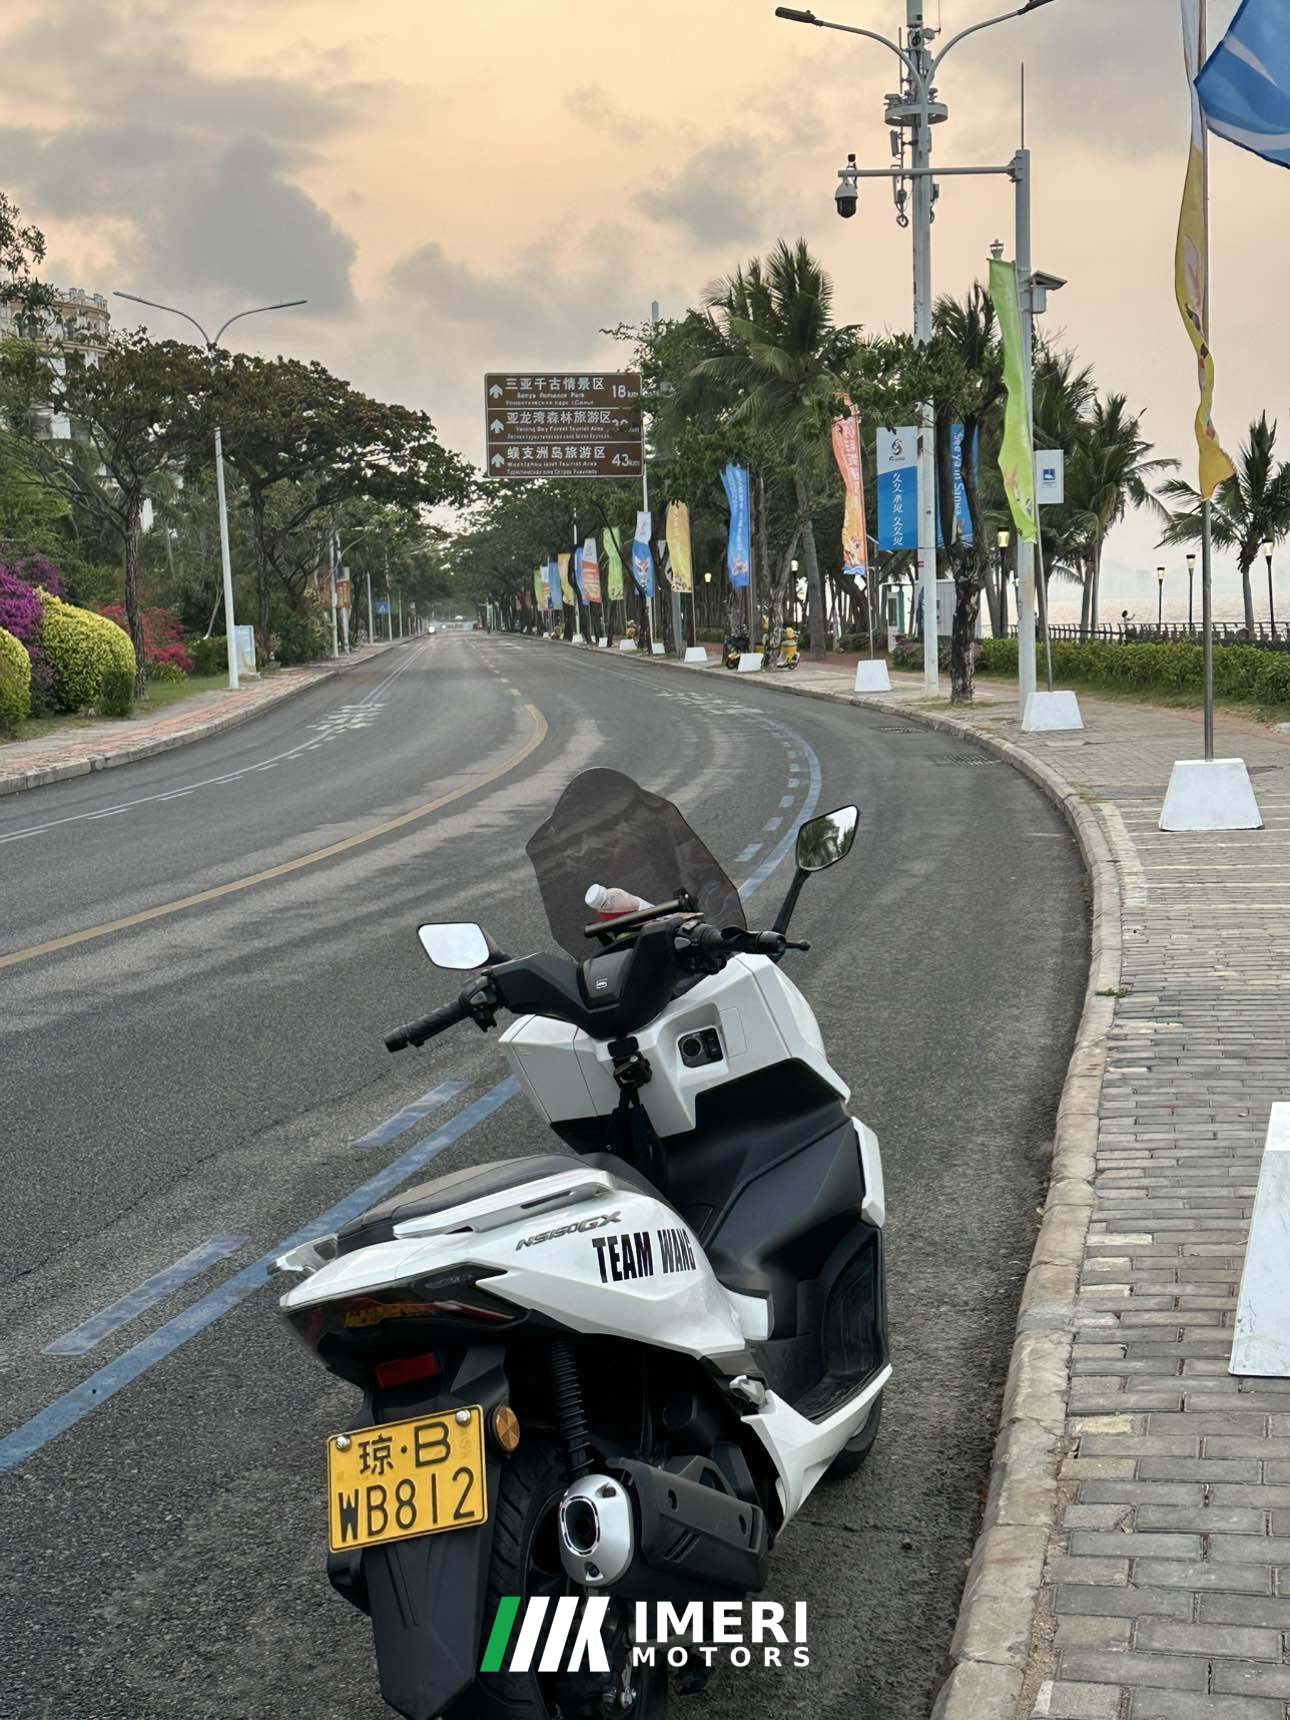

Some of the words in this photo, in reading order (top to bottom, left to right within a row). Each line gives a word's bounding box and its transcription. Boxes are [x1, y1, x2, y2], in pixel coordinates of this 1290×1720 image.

[505, 377, 605, 390] 三亚千古情景区
[506, 410, 611, 424] 亚龙湾森林旅游区
[515, 1210, 622, 1251] NS150GX
[592, 1231, 654, 1284] TEAM
[657, 1227, 697, 1274] WANG
[338, 1466, 476, 1543] WB812
